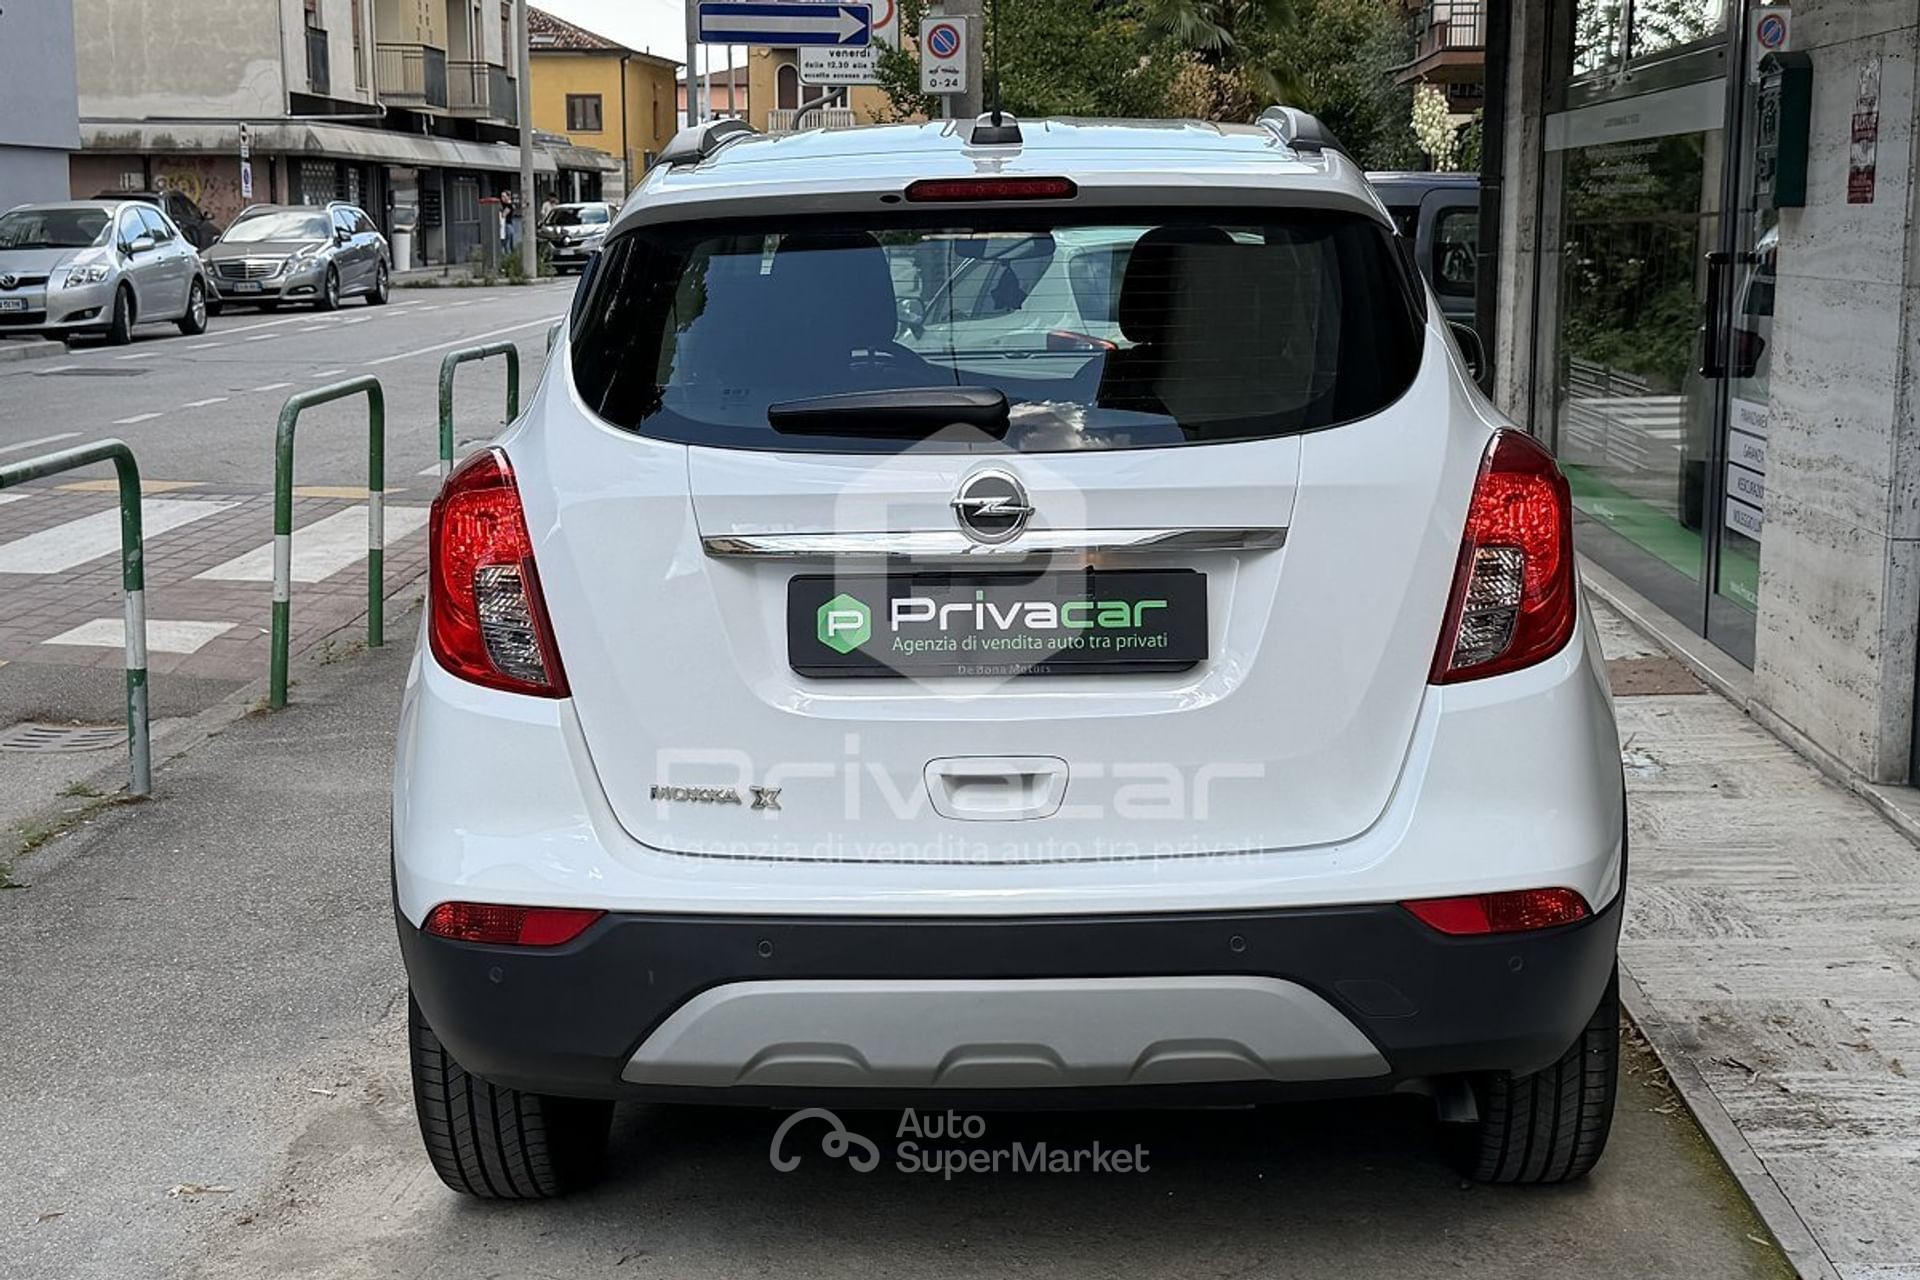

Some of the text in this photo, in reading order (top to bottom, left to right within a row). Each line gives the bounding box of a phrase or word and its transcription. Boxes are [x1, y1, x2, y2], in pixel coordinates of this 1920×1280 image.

[891, 590, 1168, 631] Privacar
[892, 632, 1168, 655] Agenzia di vendita auto tra privati
[650, 785, 782, 810] MOKKA X
